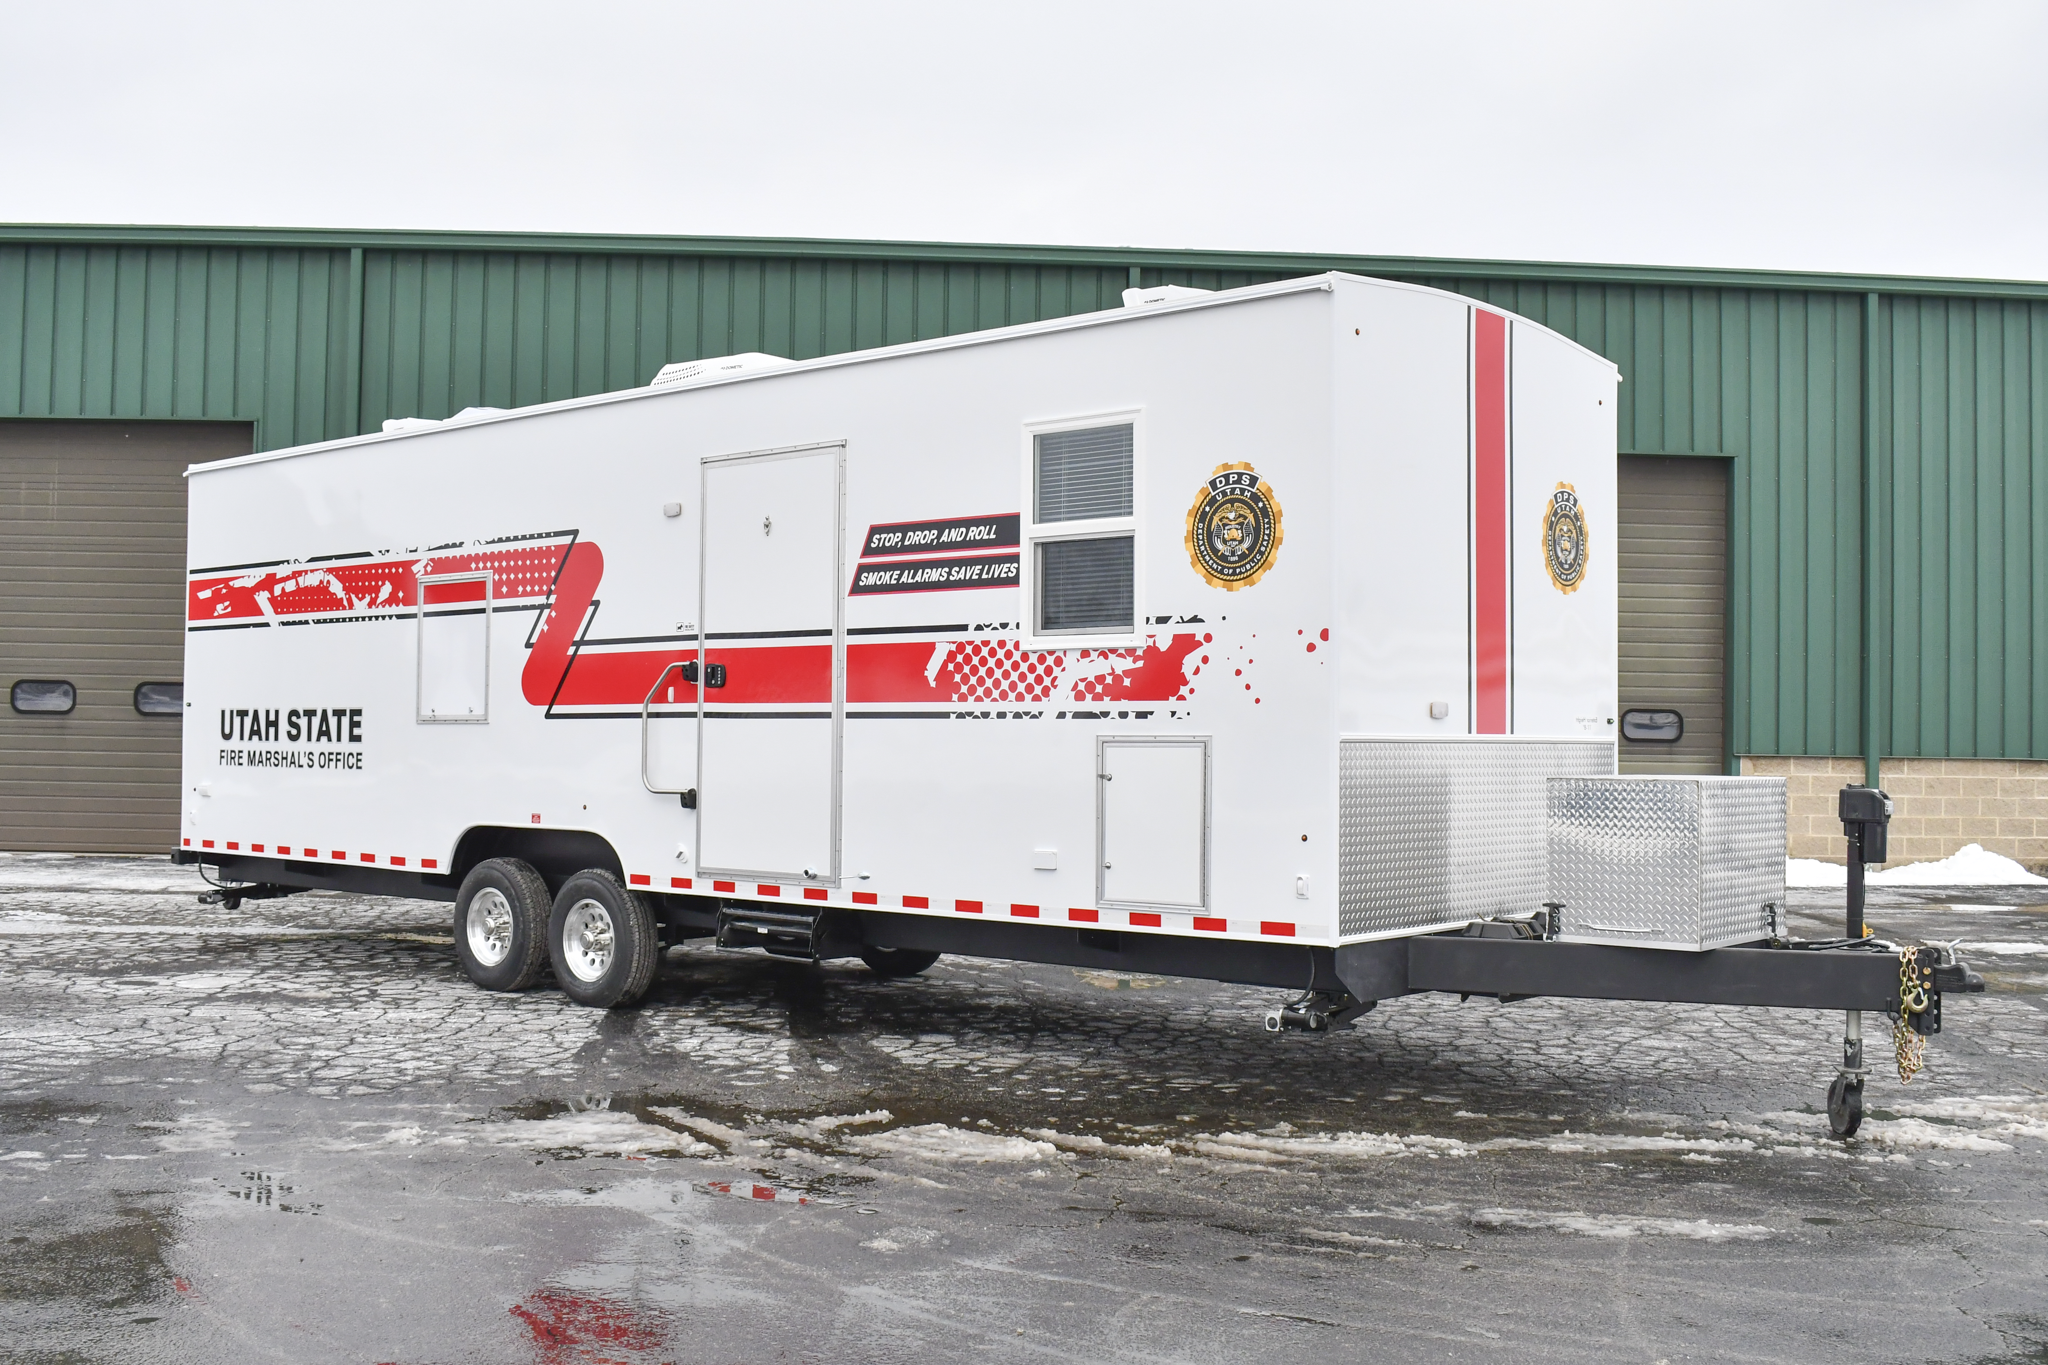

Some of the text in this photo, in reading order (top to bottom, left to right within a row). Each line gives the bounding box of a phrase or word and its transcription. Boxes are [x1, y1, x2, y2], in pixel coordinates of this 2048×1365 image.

[1216, 474, 1250, 488] DPS
[1216, 488, 1251, 500] UTAH
[1557, 493, 1574, 505] DPS
[1557, 505, 1575, 515] UTAH
[870, 524, 997, 548] STOP, DROP, AND ROLL
[1198, 523, 1221, 571] DEPARTMENT
[1236, 553, 1262, 575] PUBLIC
[1261, 518, 1269, 552] SAFETY
[859, 562, 1019, 586] SMOKE ALARMS SAVE LIVES
[220, 708, 363, 743] UTAH STATE
[219, 749, 363, 770] FIRE MARSHAL'S OFFICE
